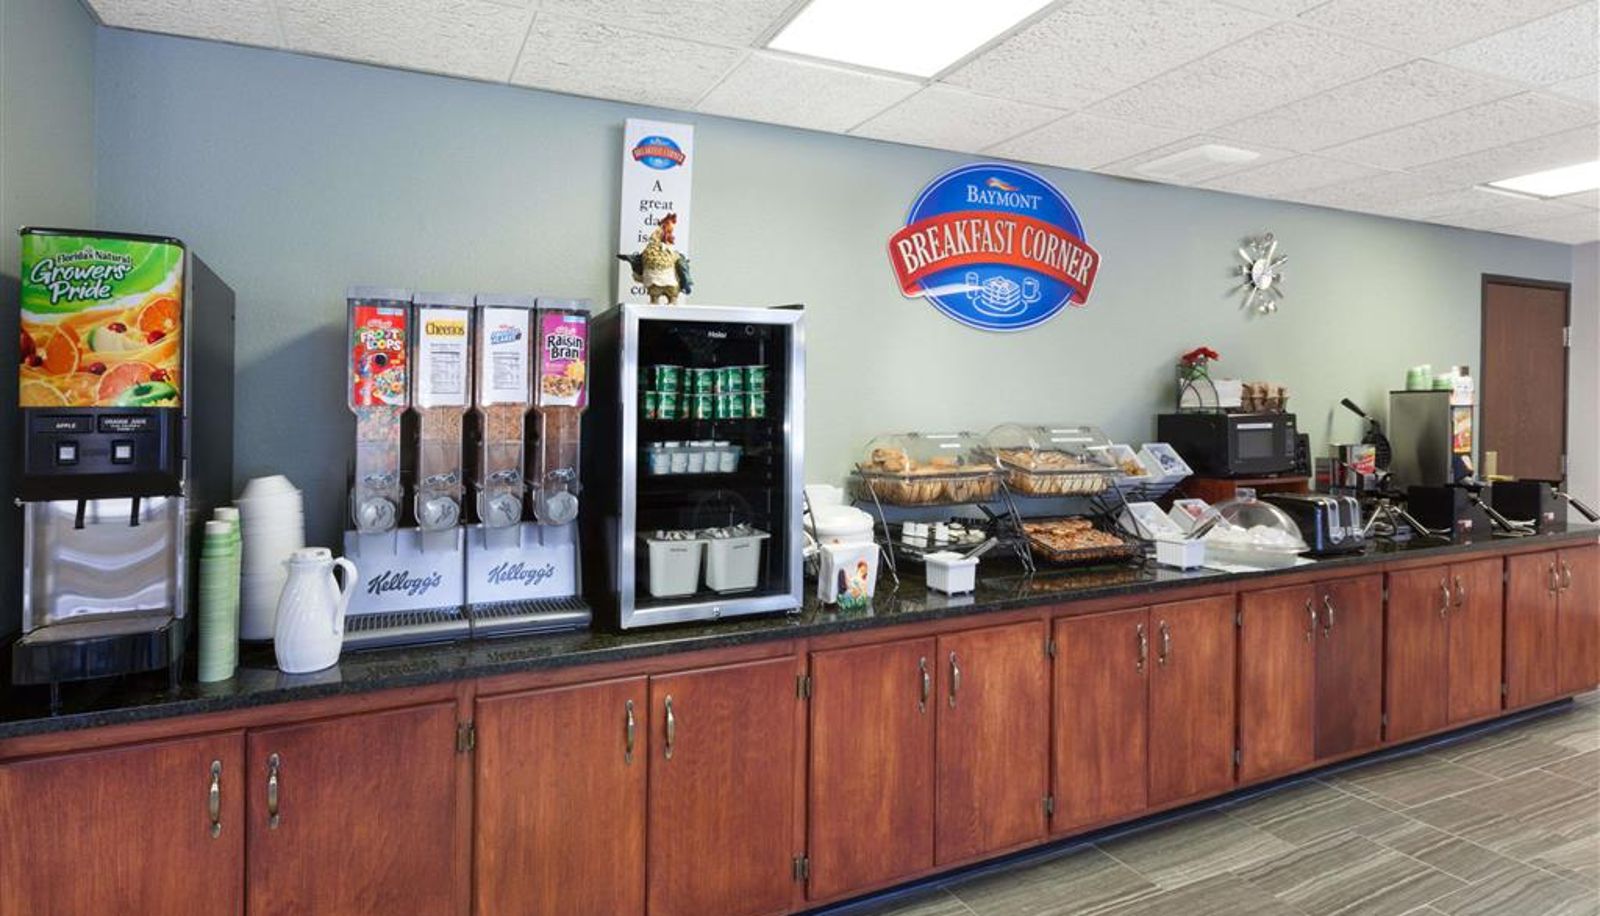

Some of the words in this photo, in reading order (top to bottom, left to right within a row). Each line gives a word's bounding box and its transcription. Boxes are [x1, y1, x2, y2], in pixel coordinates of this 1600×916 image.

[652, 180, 663, 193] A
[639, 198, 673, 212] great
[966, 184, 1041, 210] BAYMONT
[897, 218, 1017, 275] BREAKFAST
[1021, 224, 1095, 287] CORNER
[49, 280, 111, 304] Pride
[425, 320, 465, 336] Cheerios
[547, 335, 583, 348] Raisin
[551, 347, 579, 359] Bran
[367, 570, 442, 596] Kellogg's
[487, 562, 556, 586] Kellogg's
